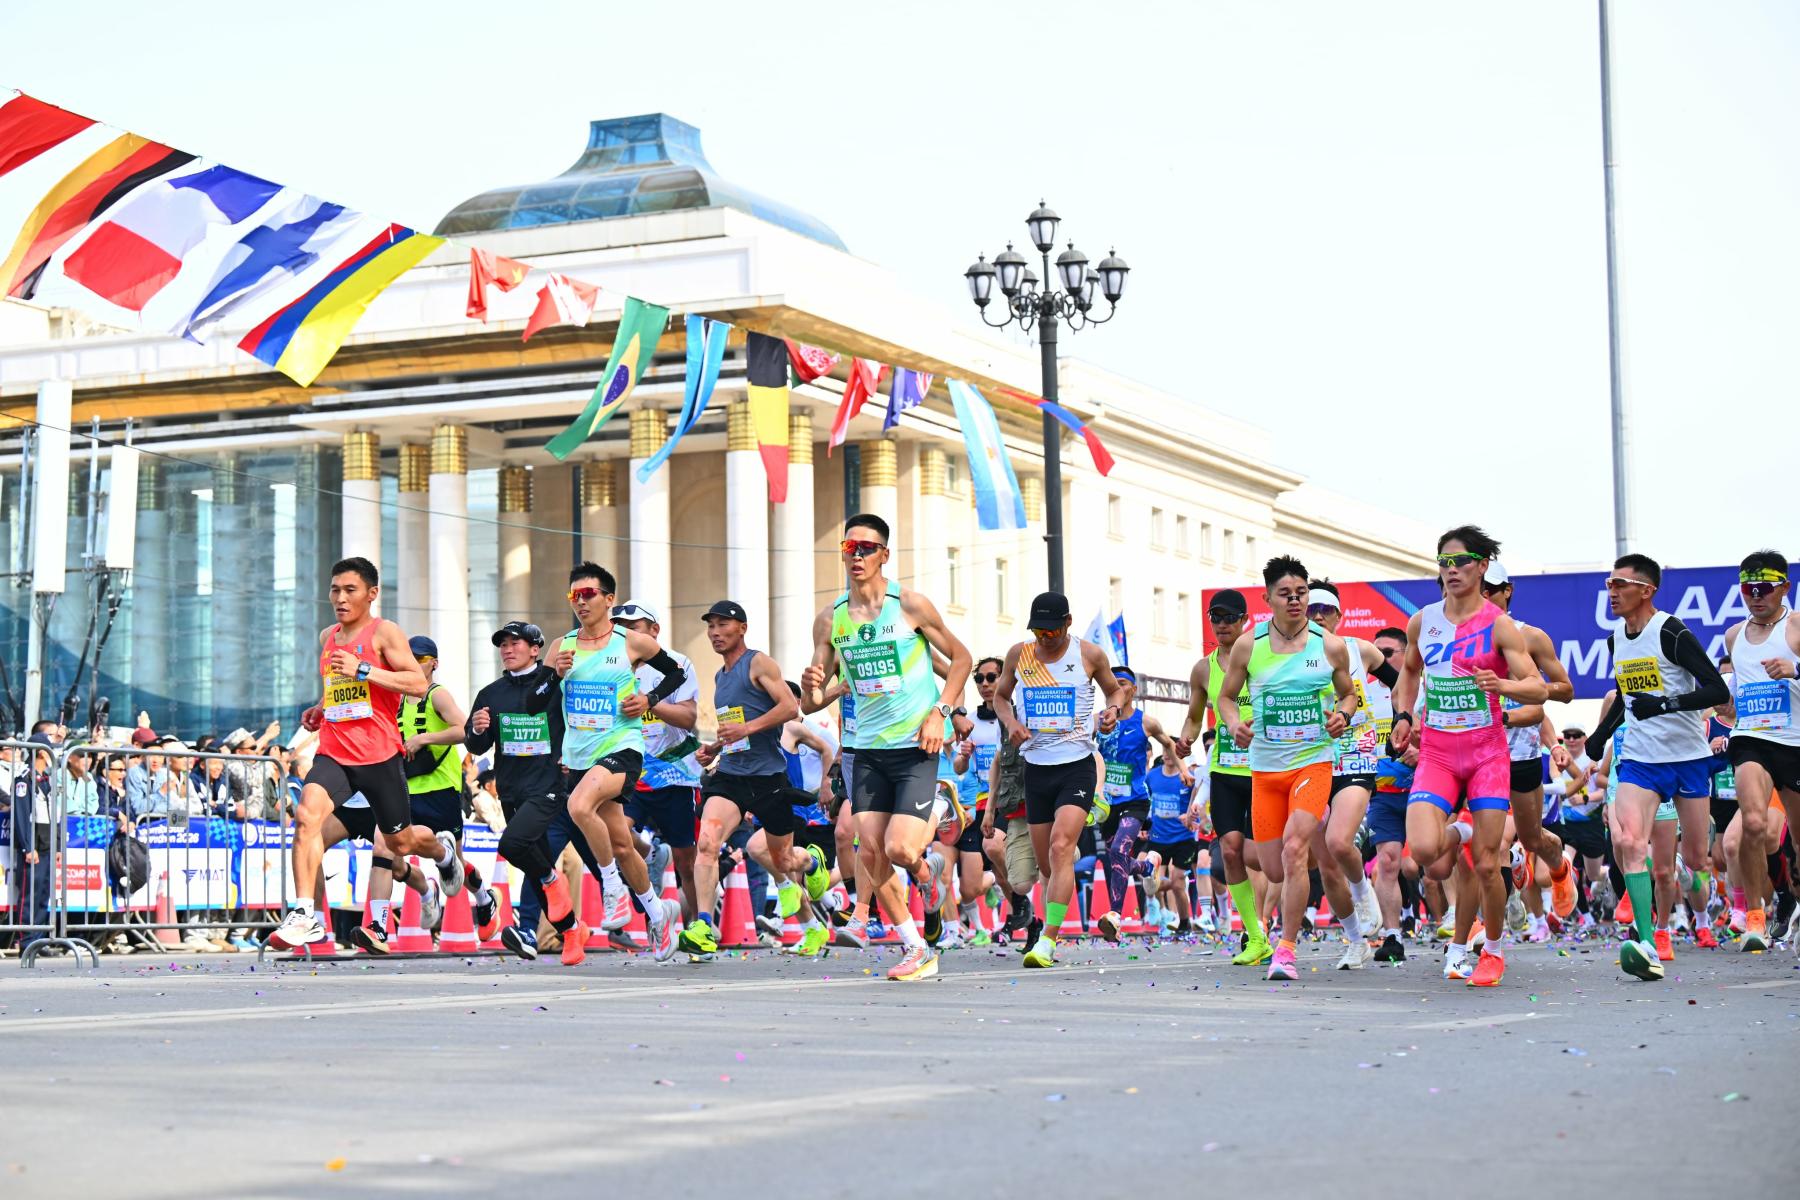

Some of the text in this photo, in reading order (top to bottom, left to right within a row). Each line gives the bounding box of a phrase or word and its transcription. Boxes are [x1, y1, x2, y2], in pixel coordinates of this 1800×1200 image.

[1344, 608, 1371, 617] Asian
[1344, 618, 1387, 628] Athletics
[834, 635, 850, 644] ELITE
[856, 659, 896, 677] 09195
[1626, 674, 1659, 691] 08243
[333, 685, 367, 703] 08024
[1438, 694, 1478, 710] 12163
[574, 697, 613, 713] 04074
[1035, 701, 1069, 715] 01001
[1746, 697, 1783, 713] 01977
[1277, 708, 1319, 724] 30394
[513, 728, 542, 741] 11777
[1106, 773, 1127, 784] 32711
